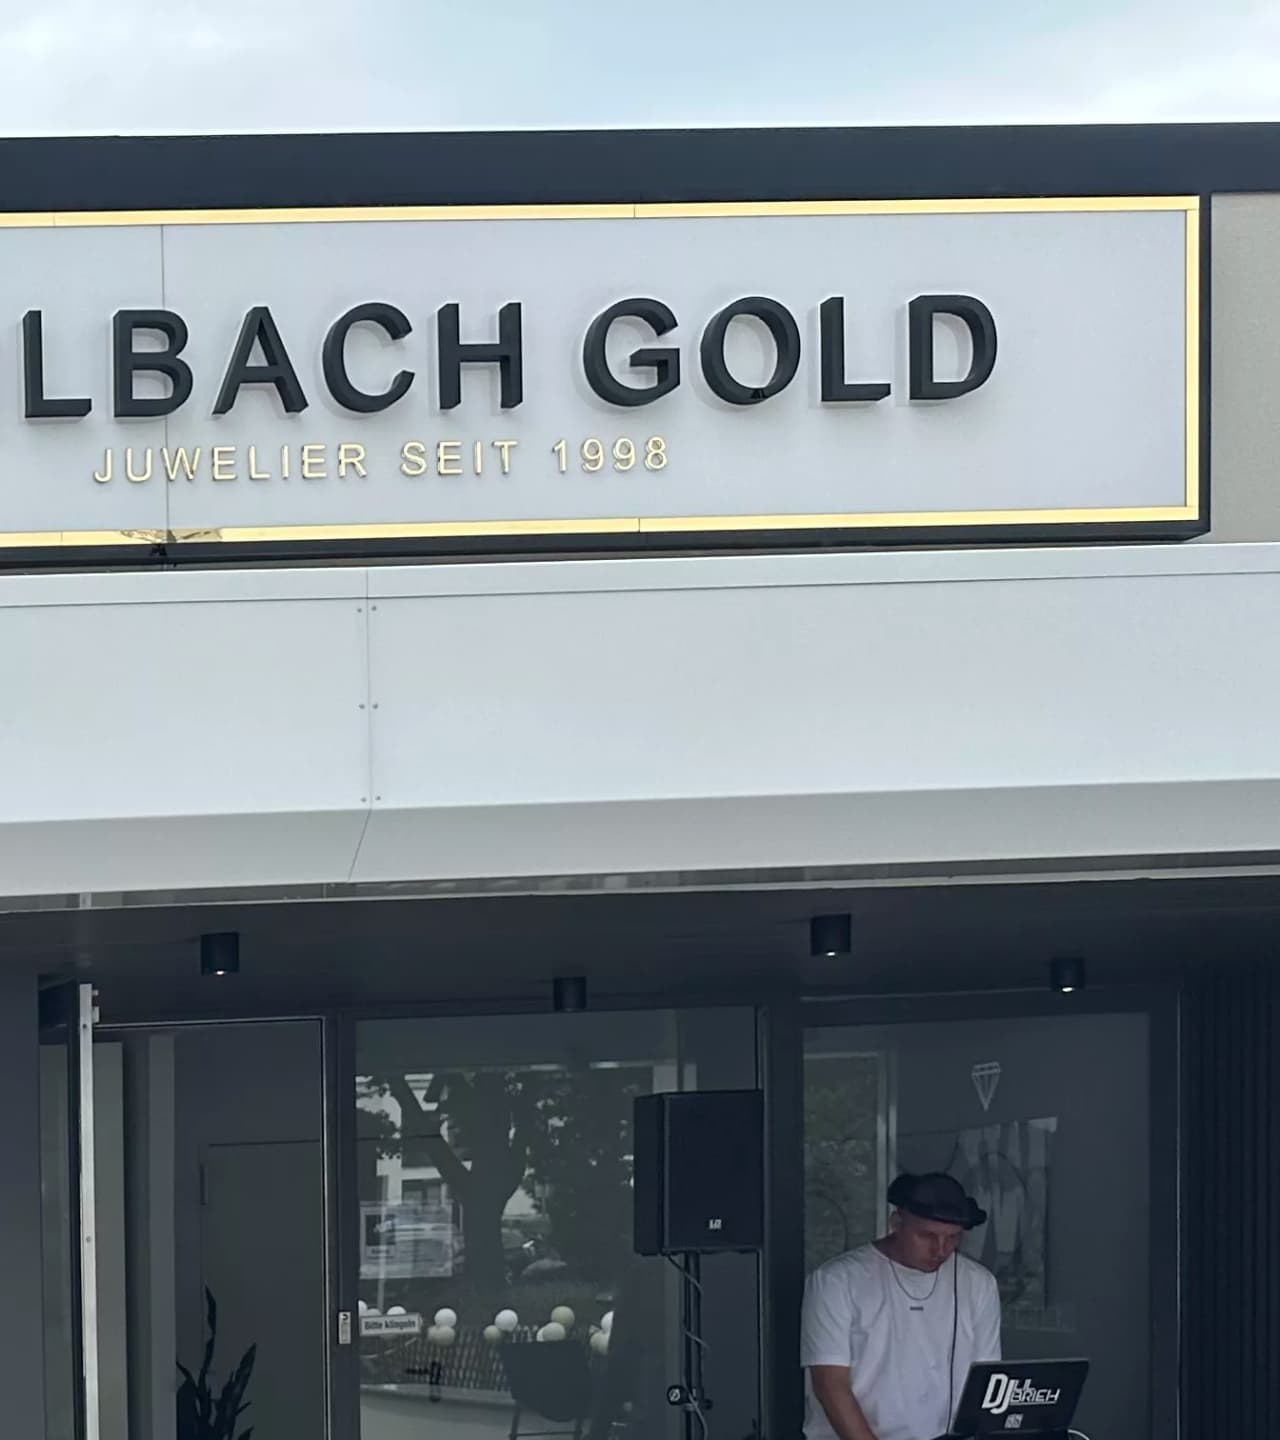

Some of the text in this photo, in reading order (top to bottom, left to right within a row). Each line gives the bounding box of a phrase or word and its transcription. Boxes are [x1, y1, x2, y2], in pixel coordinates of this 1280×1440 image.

[583, 294, 998, 406] GOLD
[92, 435, 670, 485] JUWELIER SEIT 1998
[981, 1373, 1019, 1415] DJ
